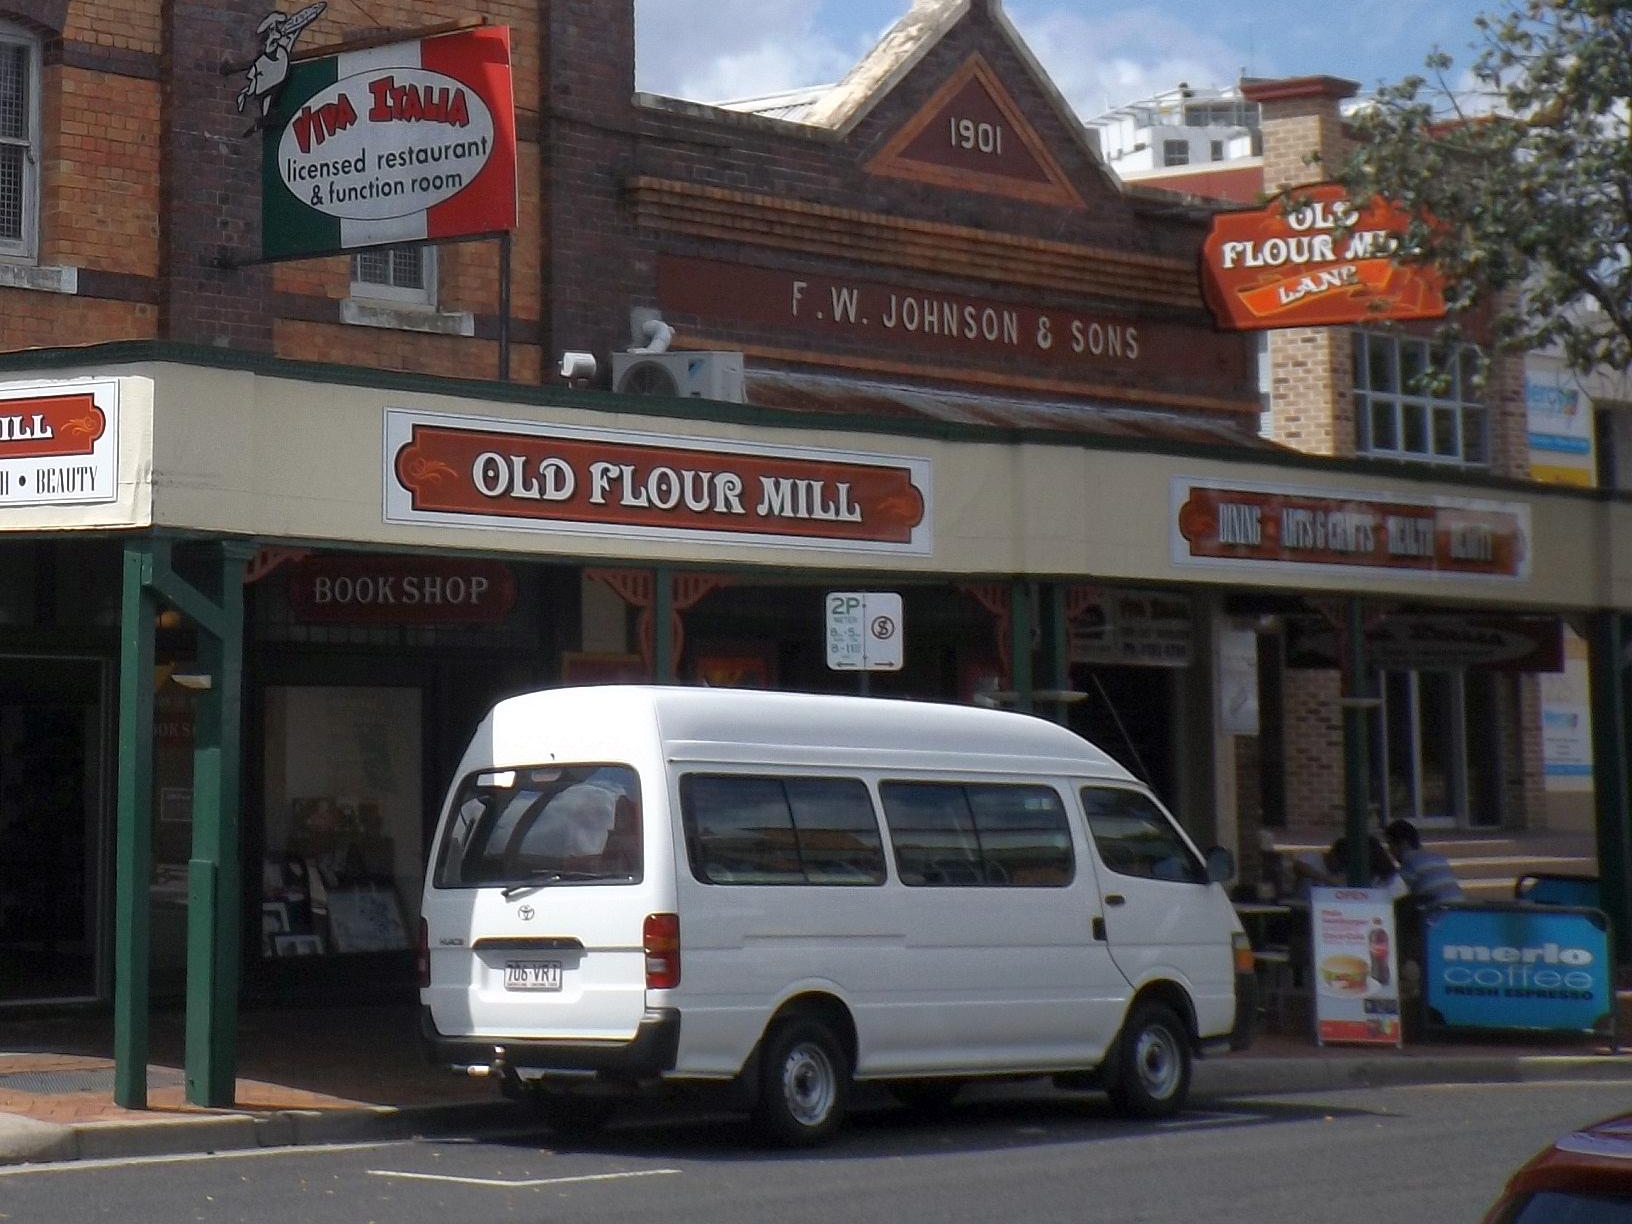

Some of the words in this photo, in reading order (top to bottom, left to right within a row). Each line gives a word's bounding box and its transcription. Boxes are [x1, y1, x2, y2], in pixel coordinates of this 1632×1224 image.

[292, 93, 358, 153] VIVA
[368, 76, 469, 128] ITALIA
[950, 117, 1002, 154] 1901
[287, 147, 366, 182] licensed
[377, 135, 488, 170] restaurant
[310, 184, 324, 206] &
[329, 177, 404, 204] function
[411, 171, 463, 193] room
[1222, 234, 1337, 268] FLOUR
[883, 294, 1018, 345] JOHNSON
[1036, 316, 1053, 350] &
[1072, 319, 1139, 360] SONS
[36, 466, 98, 494] BEAUTY
[472, 451, 576, 502] OLD
[589, 461, 745, 515] FLOUR
[757, 476, 862, 523] MILL
[832, 597, 860, 615] 2P
[1443, 942, 1593, 966] merlo
[1444, 963, 1592, 989] coffee
